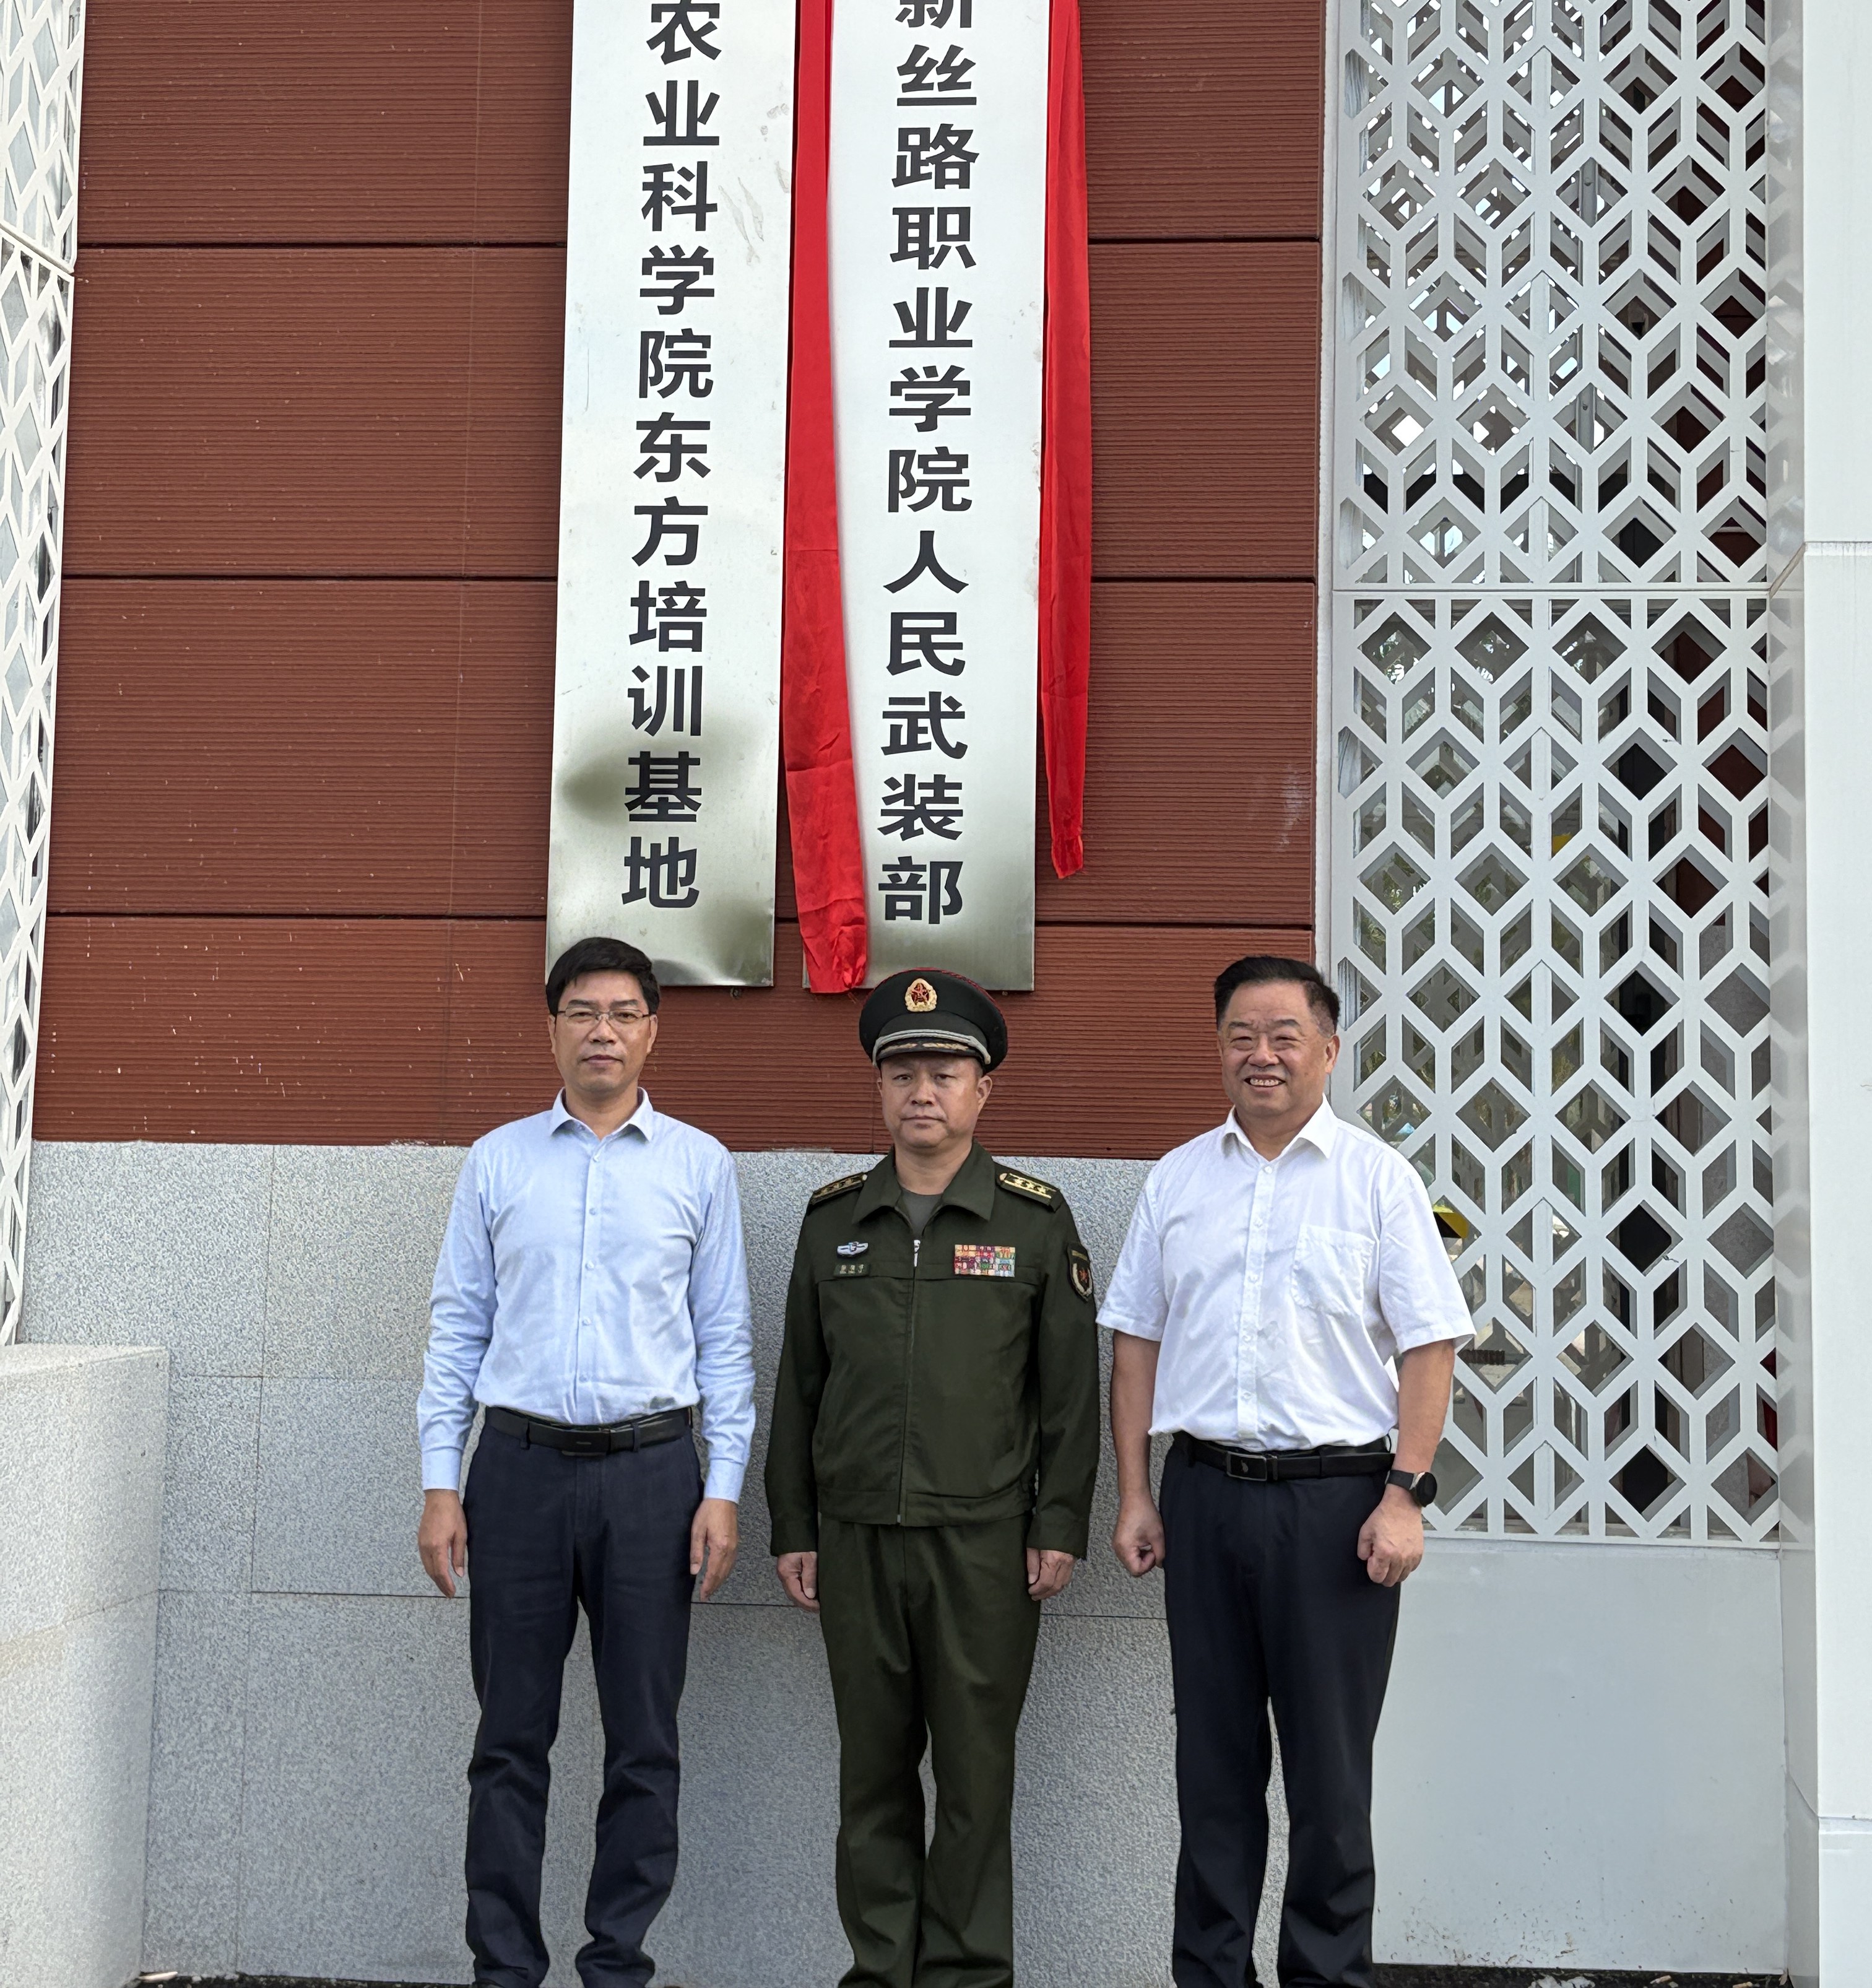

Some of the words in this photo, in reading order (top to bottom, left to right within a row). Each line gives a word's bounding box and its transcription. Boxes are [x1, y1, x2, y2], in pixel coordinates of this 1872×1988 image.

[621, 0, 722, 909] 农业科学院东方培训基地
